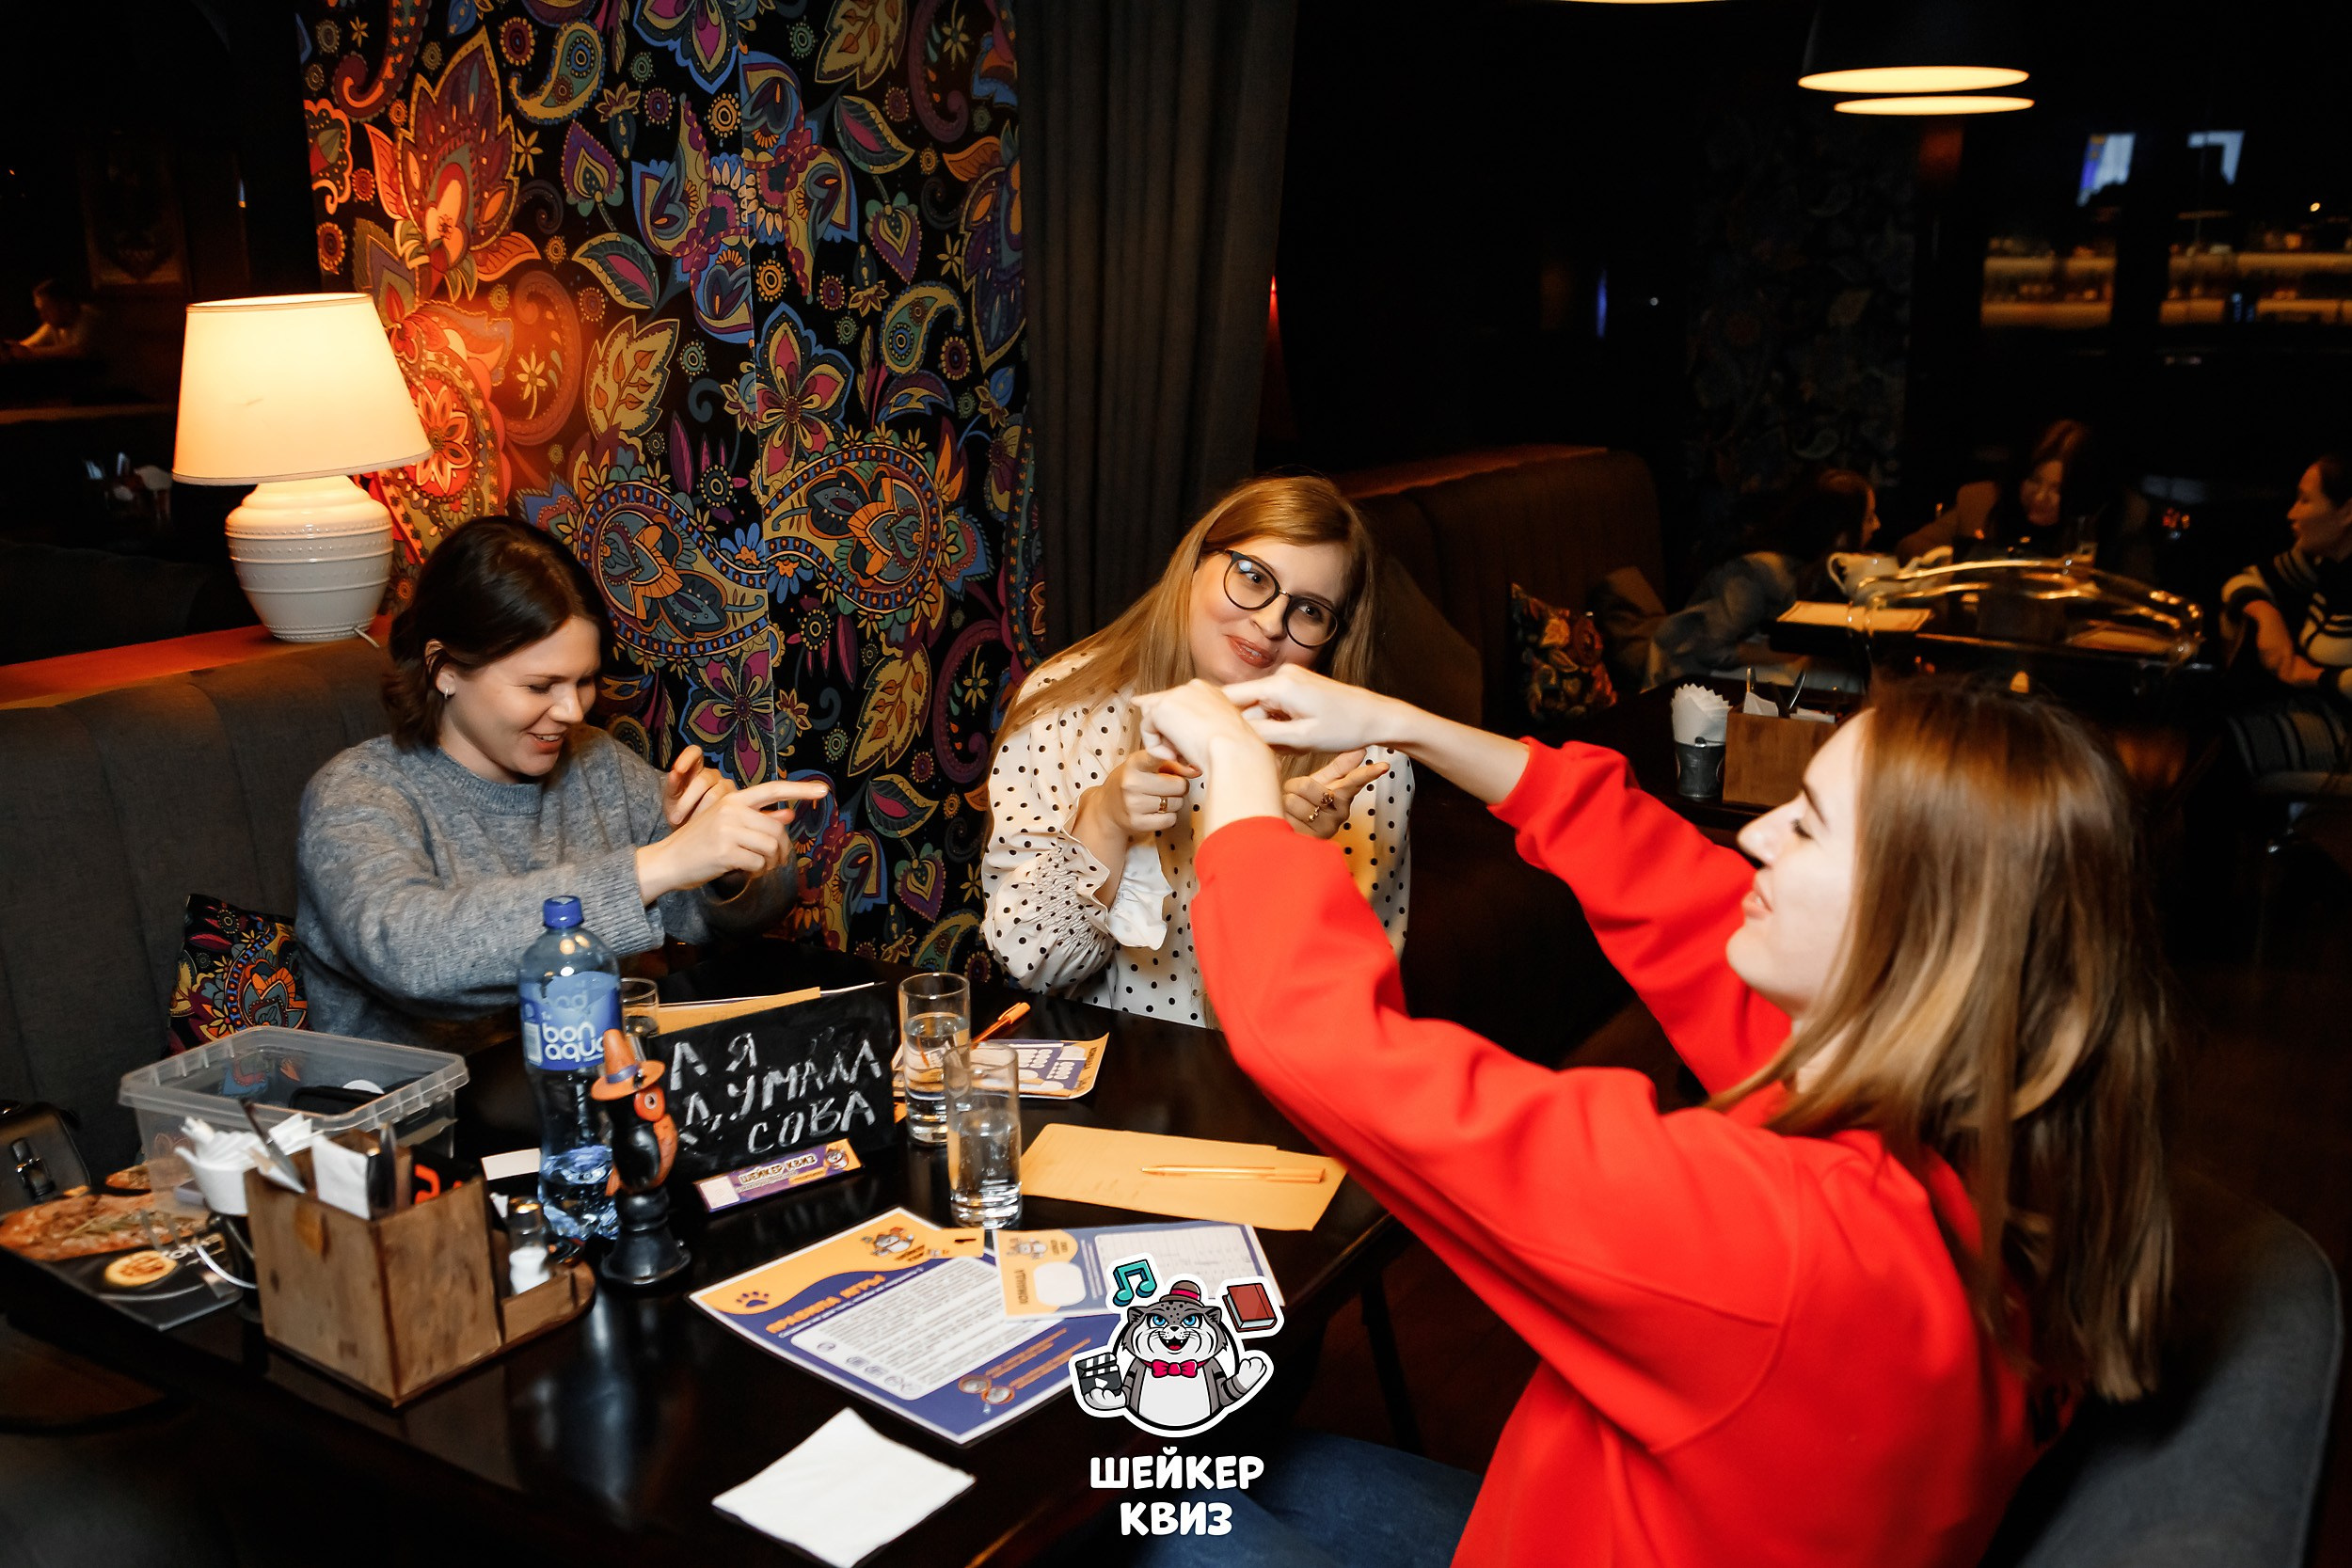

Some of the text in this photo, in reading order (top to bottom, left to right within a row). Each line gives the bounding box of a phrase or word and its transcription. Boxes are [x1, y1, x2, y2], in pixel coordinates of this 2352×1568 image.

[542, 1022, 596, 1043] bon
[725, 1032, 757, 1072] Я
[748, 1090, 876, 1154] СОВА
